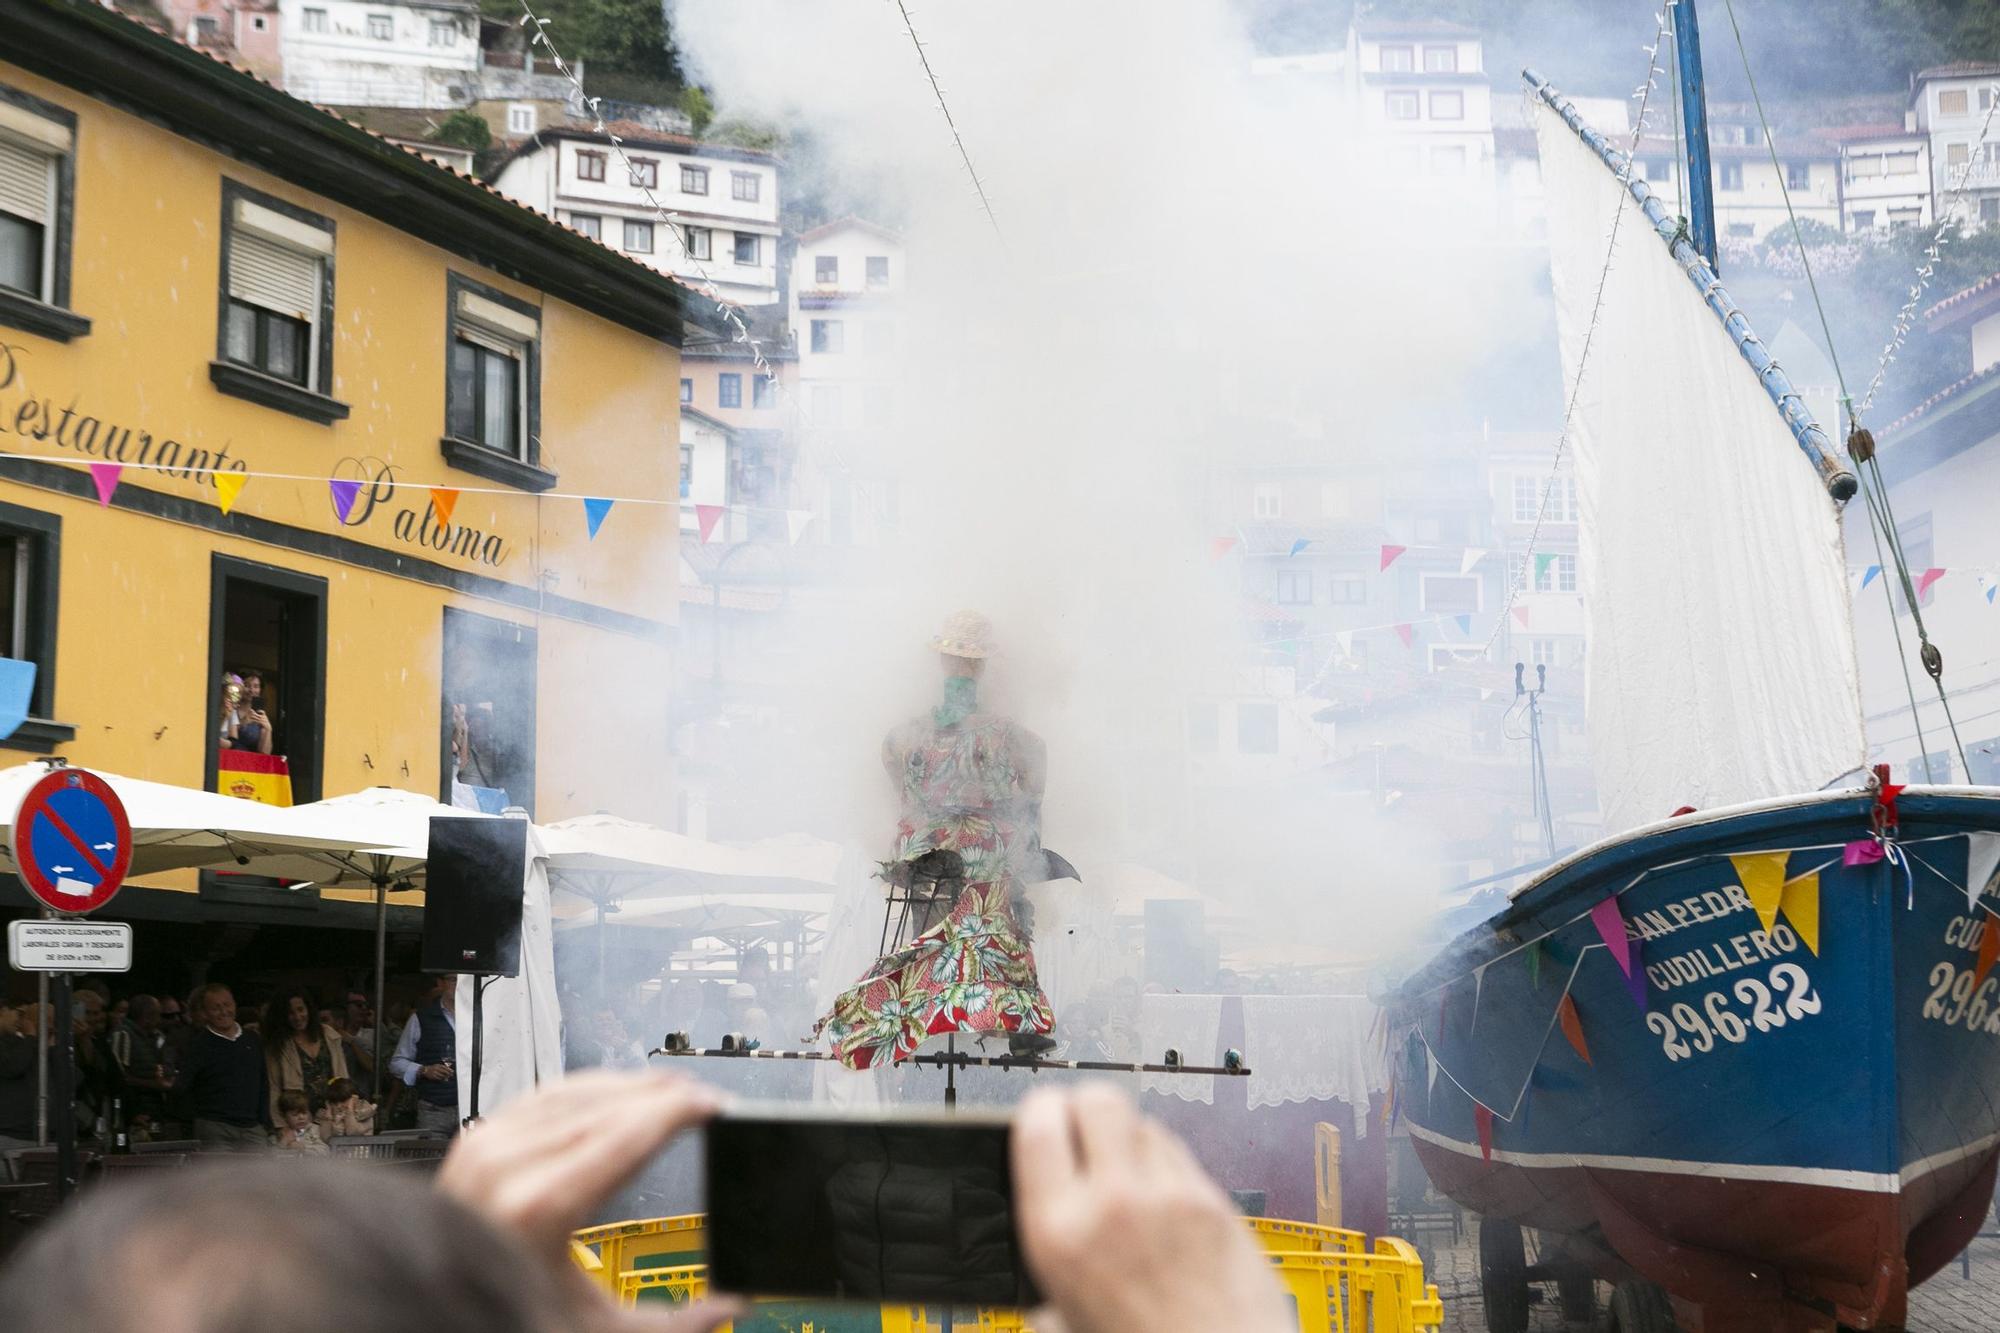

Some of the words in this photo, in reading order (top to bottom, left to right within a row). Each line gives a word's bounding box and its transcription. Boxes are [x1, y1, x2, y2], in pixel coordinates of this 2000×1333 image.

[329, 456, 511, 568] Paloma
[1666, 884, 1755, 928] PEDR
[1646, 923, 1798, 991] CUDILLERO
